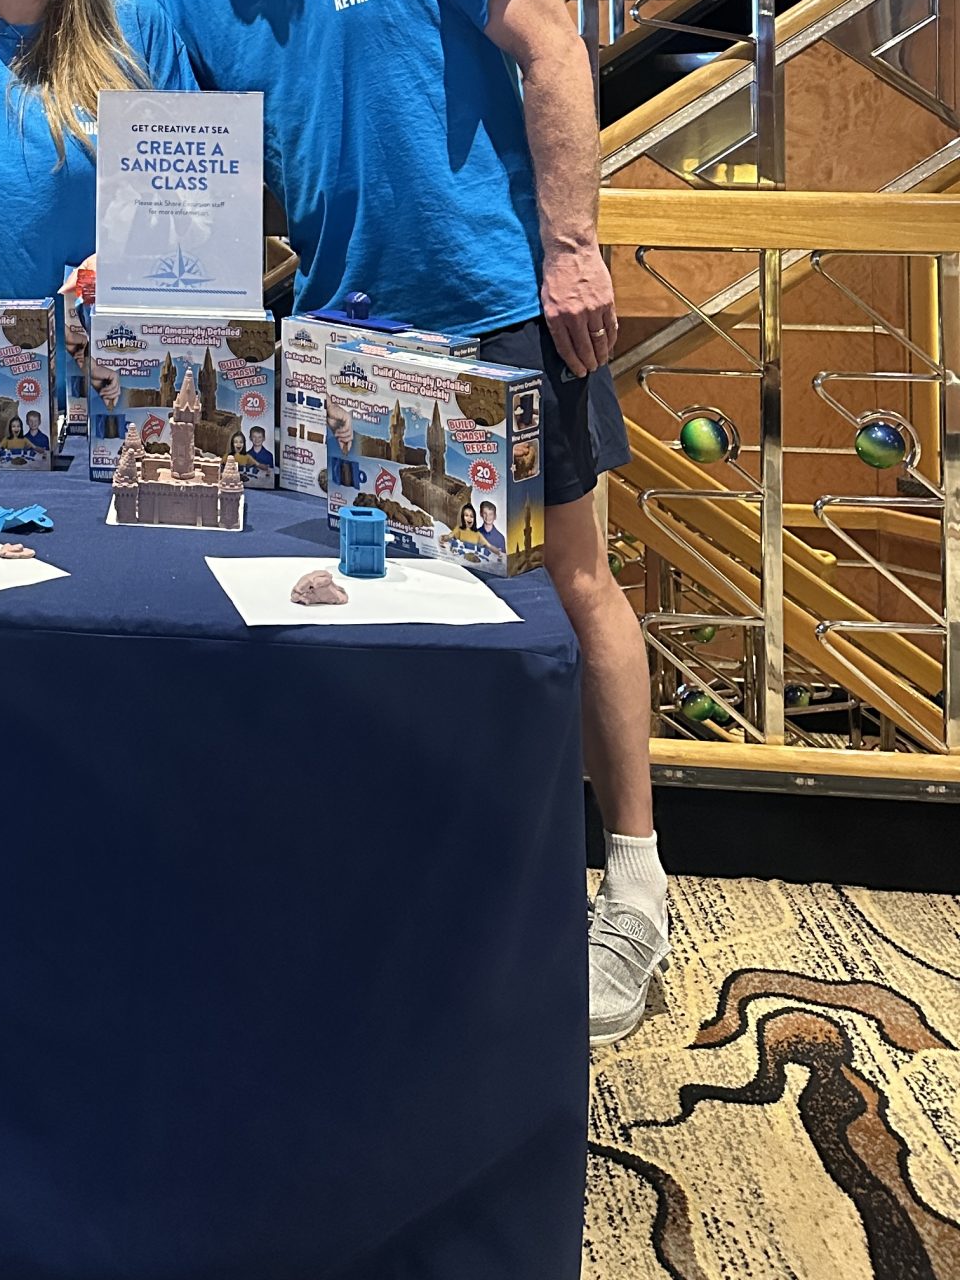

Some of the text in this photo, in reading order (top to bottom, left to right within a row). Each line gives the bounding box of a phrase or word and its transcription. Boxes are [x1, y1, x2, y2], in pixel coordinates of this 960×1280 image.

[131, 124, 229, 134] GET CREATIVE AT SEA
[136, 140, 224, 156] CREATE A
[121, 157, 239, 174] SANDCASTLE
[151, 175, 208, 191] CLASS
[142, 326, 240, 337] Build Amazingly Detailed
[161, 336, 221, 347] Castles Quickly
[4, 353, 30, 366] SMASH
[129, 360, 142, 368] Dry
[219, 359, 246, 370] BUILD
[11, 361, 41, 374] REPEAT
[227, 367, 255, 379] SMASH
[235, 375, 267, 388] REPEAT
[373, 366, 470, 393] Build Amazingly Detailed
[23, 383, 35, 392] 20
[391, 381, 450, 402] Castles Quickly
[246, 397, 259, 407] 20
[332, 396, 388, 414] Does Not Dry Out!
[448, 419, 475, 430] BUILD
[456, 431, 485, 441] SMASH
[464, 443, 497, 453] REPEAT
[477, 466, 490, 478] 20
